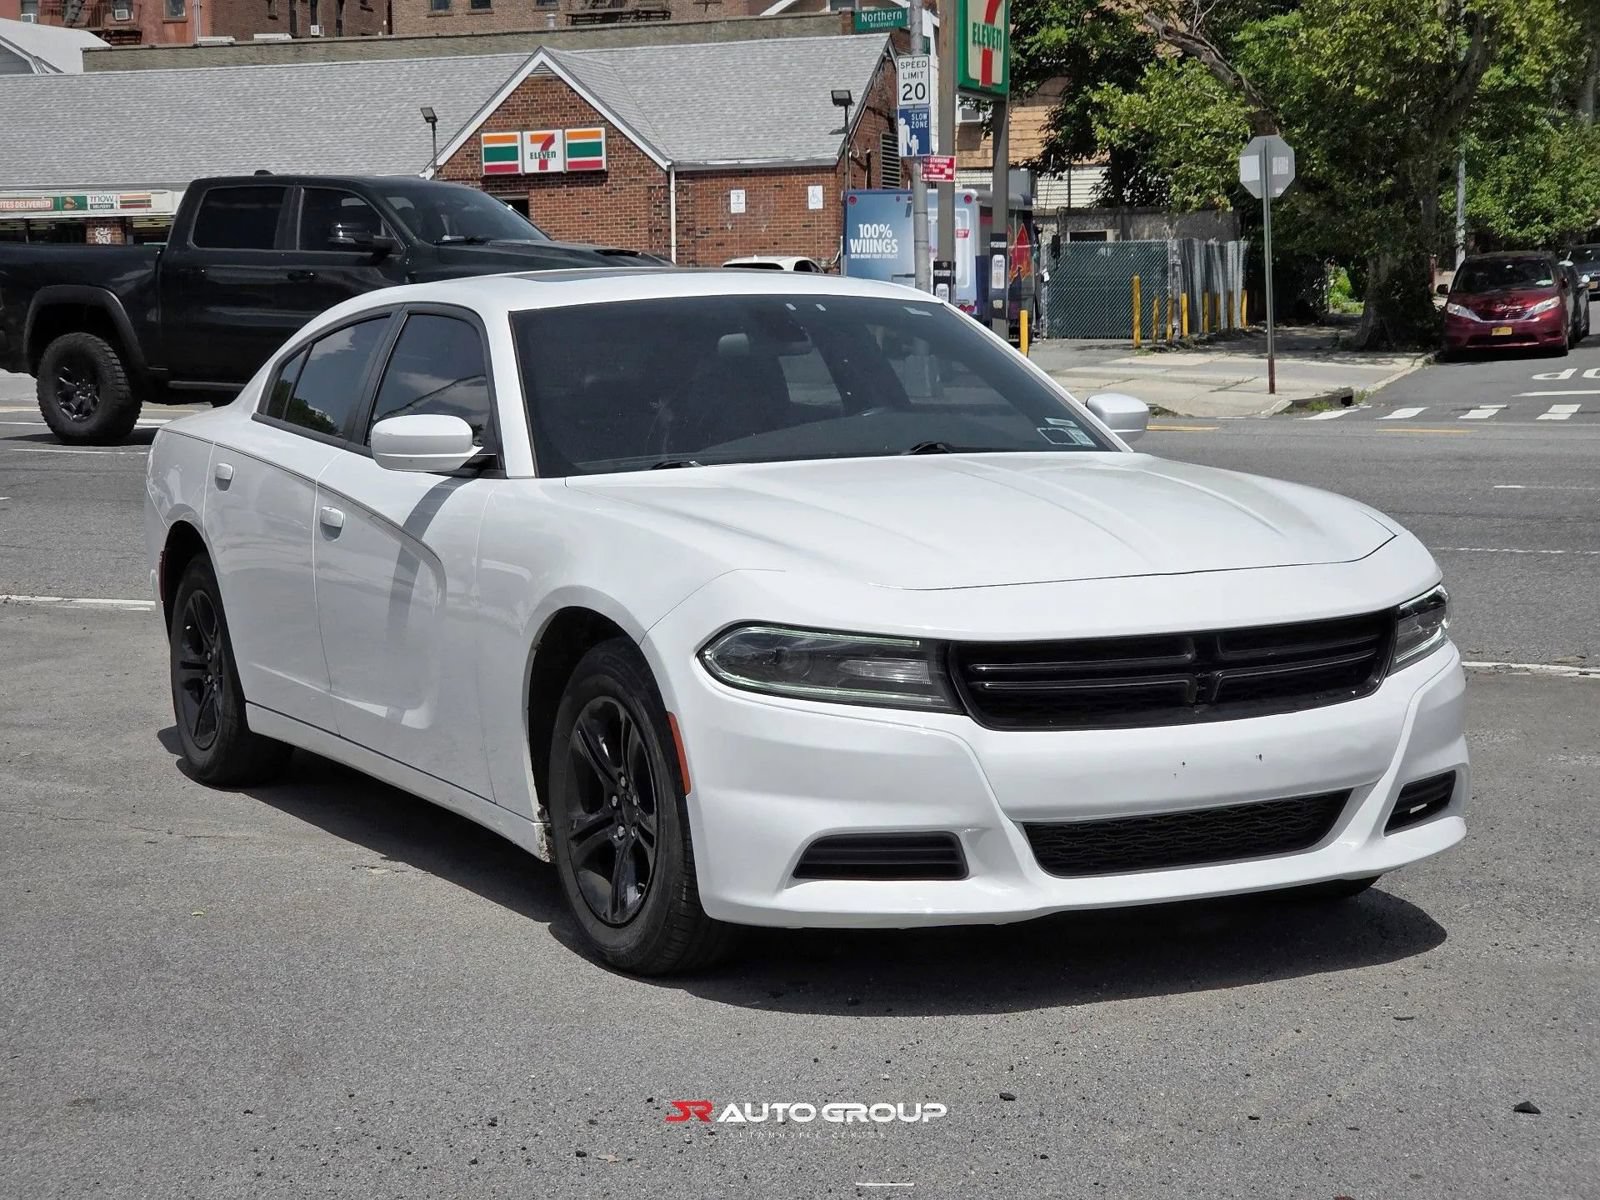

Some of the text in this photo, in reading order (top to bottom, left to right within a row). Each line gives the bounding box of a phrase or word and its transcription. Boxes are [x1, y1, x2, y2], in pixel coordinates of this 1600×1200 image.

[861, 11, 903, 23] Northern
[900, 60, 927, 70] SPEED
[902, 71, 925, 80] LIMIT
[902, 82, 926, 101] 20
[911, 112, 929, 121] SLOW
[911, 120, 929, 129] ZONE
[530, 133, 556, 171] 7
[858, 223, 893, 239] 100%
[849, 238, 898, 254] WIIINGS
